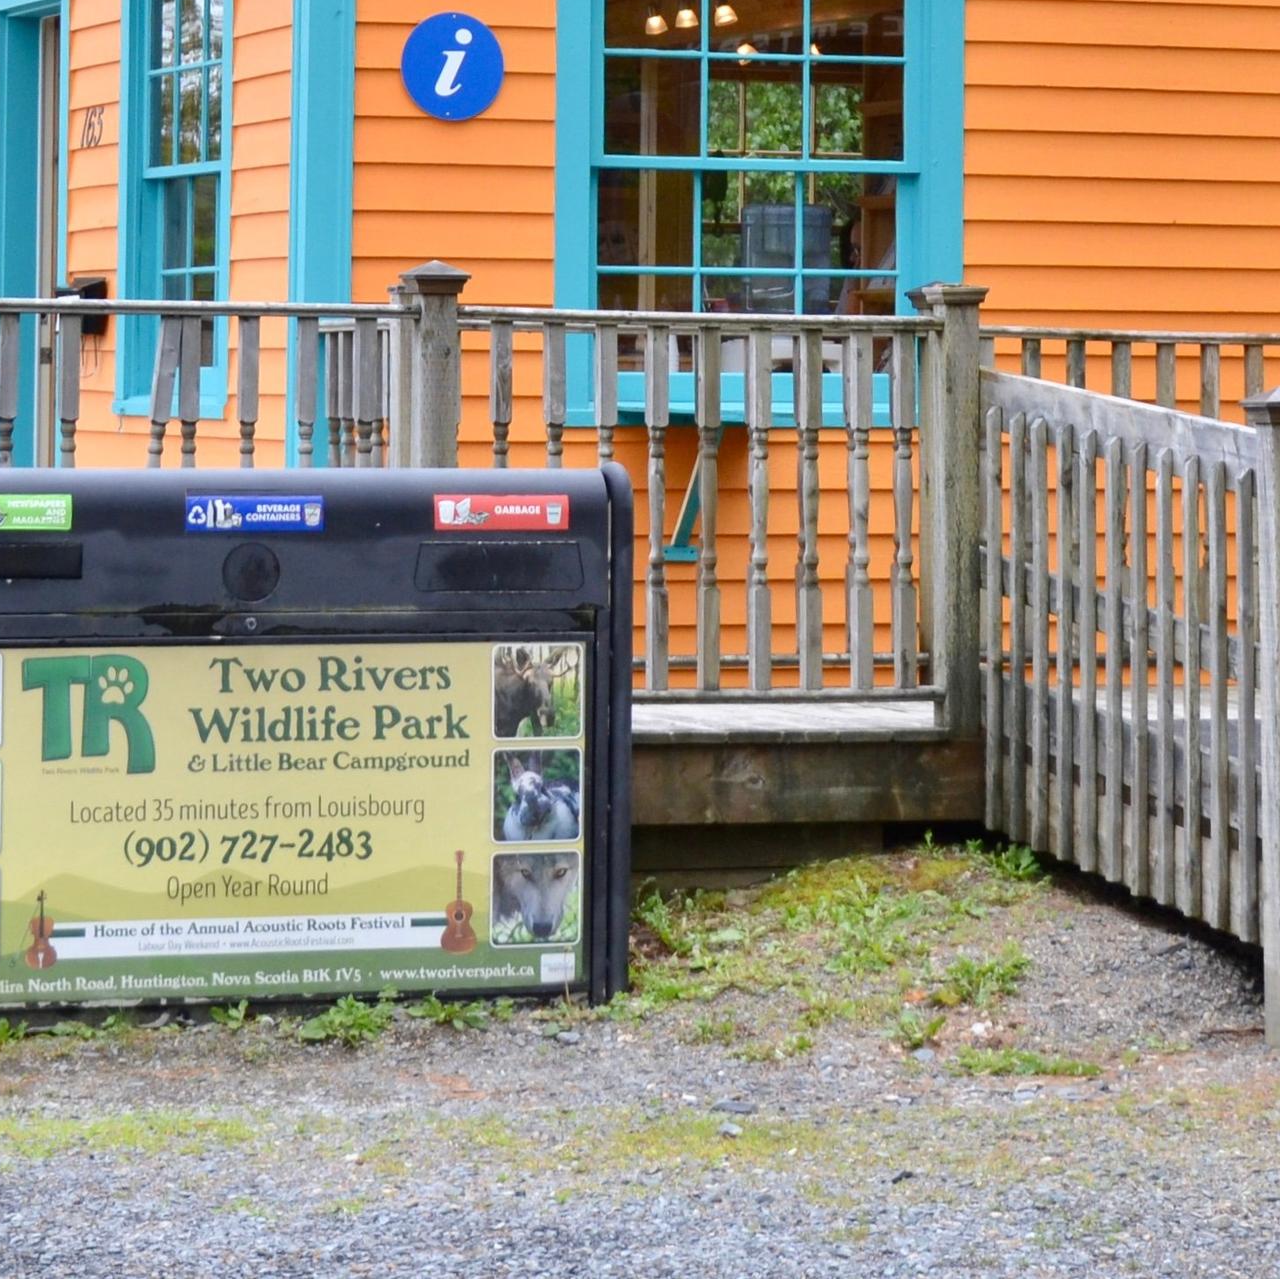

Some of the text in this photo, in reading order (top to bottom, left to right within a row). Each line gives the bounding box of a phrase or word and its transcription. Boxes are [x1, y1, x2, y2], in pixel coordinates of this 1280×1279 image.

[7, 499, 66, 508] NEWSPAPERS
[46, 508, 67, 516] AND
[256, 503, 301, 513] BEVERAGE
[494, 505, 542, 515] GARBAGE
[12, 516, 66, 525] MAGAZINES
[245, 512, 301, 522] CONTAINERS
[209, 655, 452, 694] Two Rivers
[188, 703, 470, 744] Wildlife Park
[187, 749, 470, 773] & Little Bear Campground
[70, 794, 426, 824] Located 35 minutes from Louisbourg
[123, 827, 374, 867] (902) 727-2483
[166, 872, 329, 906] Open Year Round
[94, 916, 406, 938] Home of the Annual Acoustic Roots Festival
[138, 936, 354, 953] Labour Day Weekend www.AcousticRootsFestival.com
[28, 977, 71, 993] North
[75, 976, 118, 992] Road,
[121, 973, 208, 991] Huntington,
[212, 971, 251, 987] Nova
[255, 969, 300, 985] Scotia
[380, 963, 535, 980] www.tworiverspark.ca
